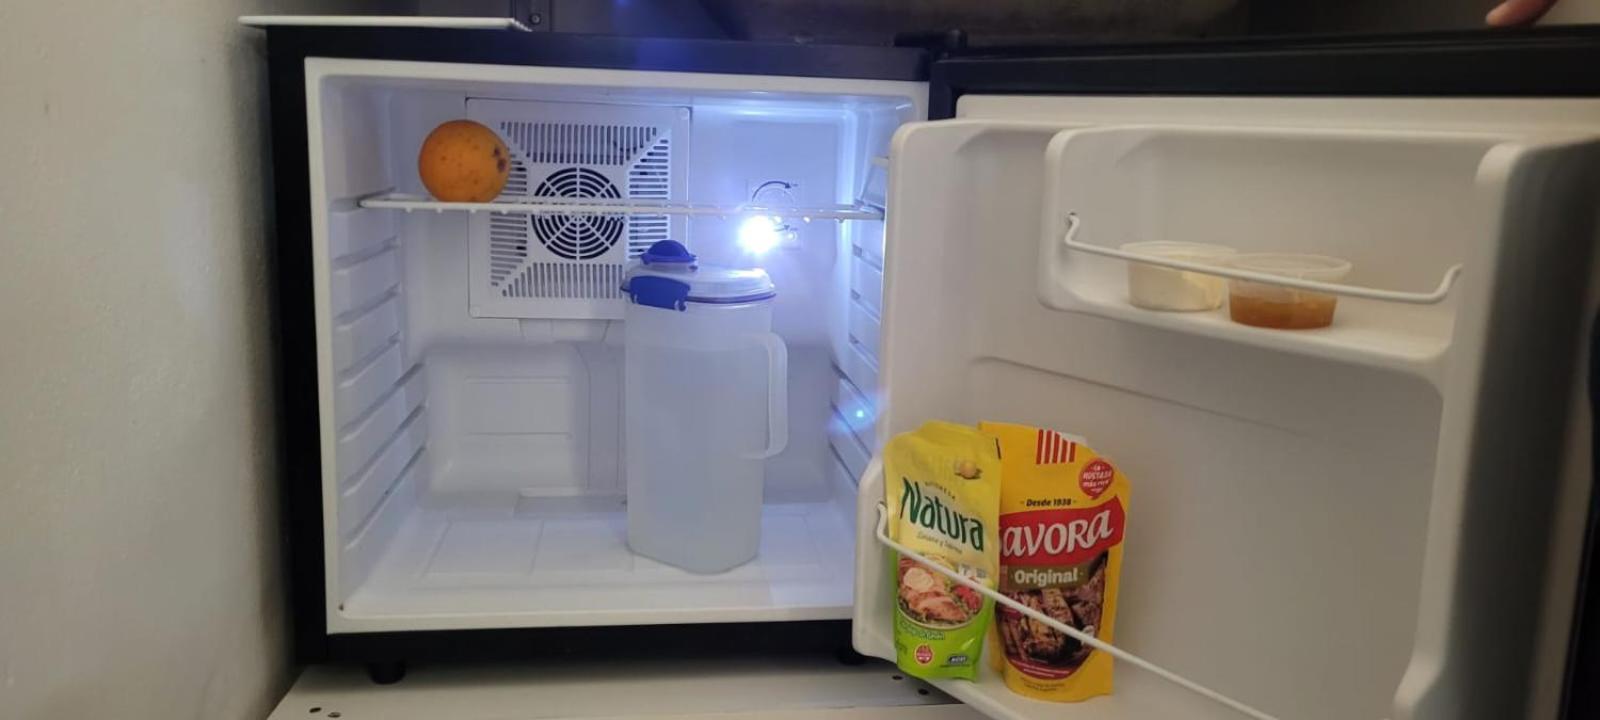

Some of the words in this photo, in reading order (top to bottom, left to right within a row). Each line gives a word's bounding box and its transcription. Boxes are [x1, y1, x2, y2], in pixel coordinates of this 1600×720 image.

[1026, 499, 1051, 507] Desde
[900, 476, 984, 552] Natura
[1015, 568, 1078, 586] Original
